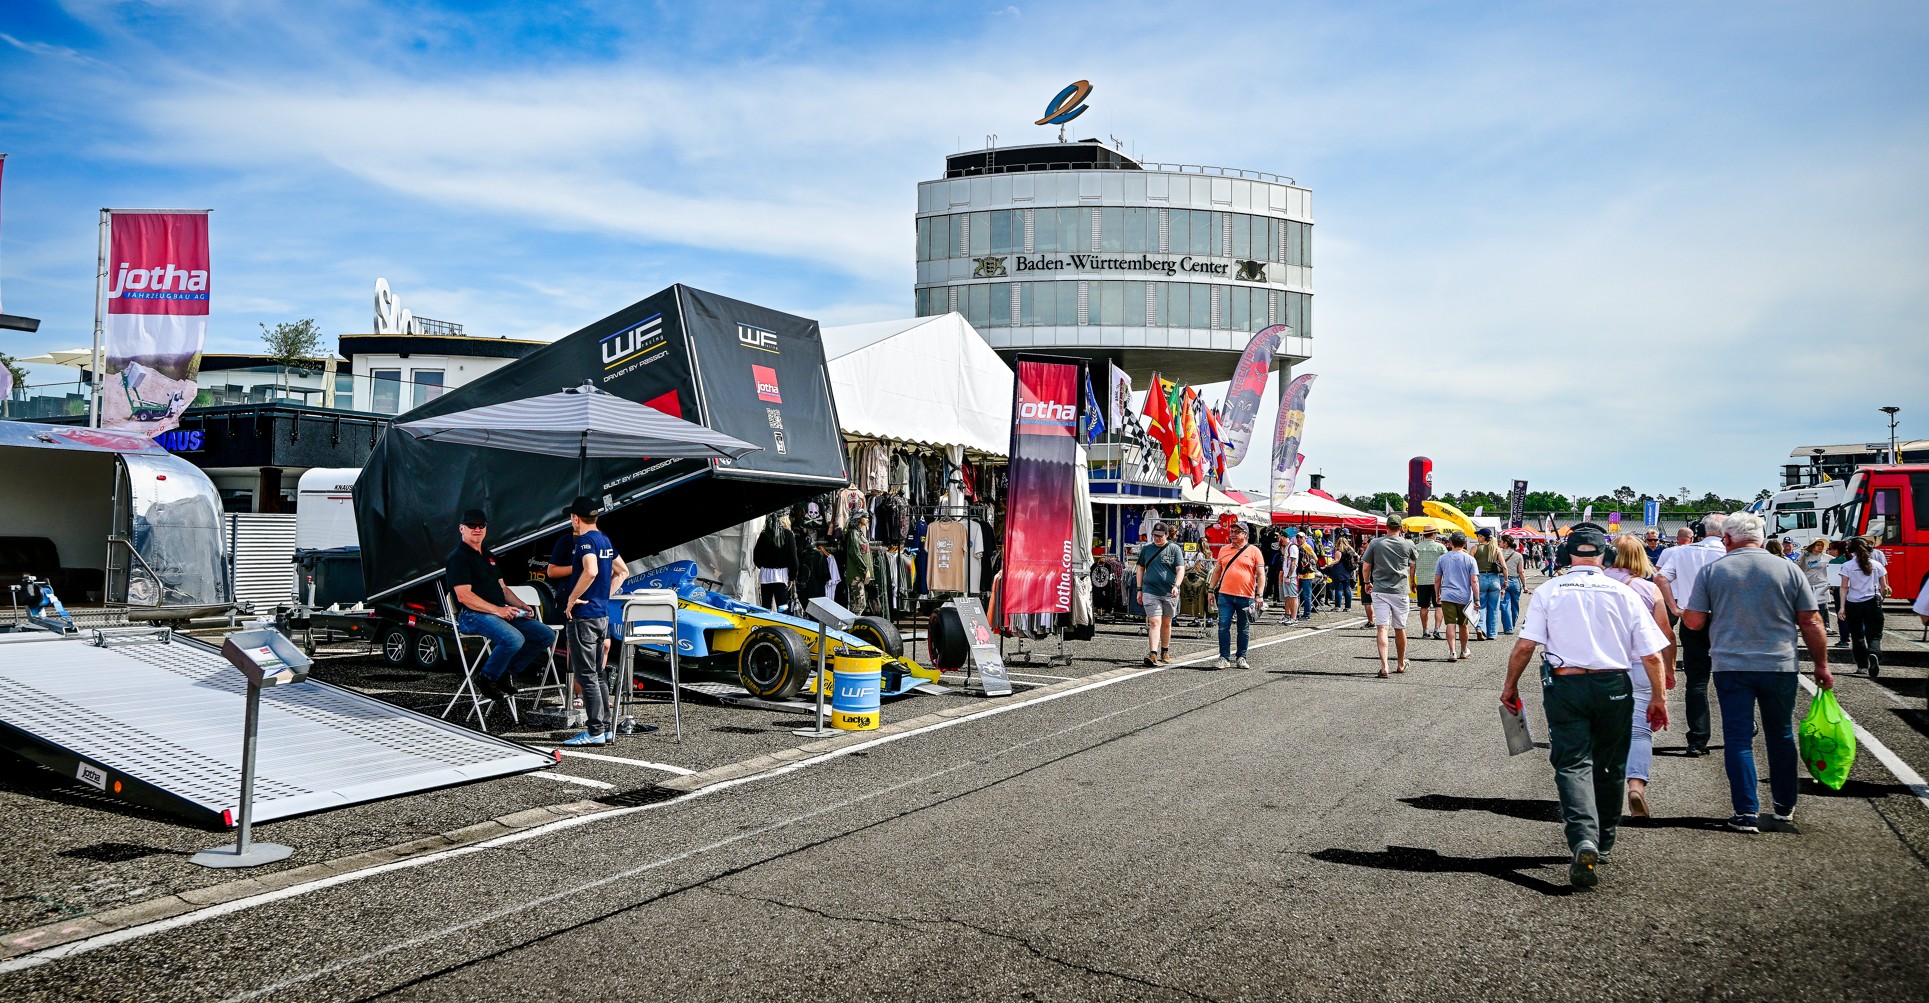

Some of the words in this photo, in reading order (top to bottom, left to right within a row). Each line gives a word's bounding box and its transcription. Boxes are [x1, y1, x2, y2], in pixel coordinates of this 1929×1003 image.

[1016, 254, 1177, 276] Baden-Württemberg
[1180, 256, 1229, 274] Center
[108, 262, 208, 299] jotha
[127, 292, 190, 300] FAHRZEUGBAU
[602, 317, 662, 364] WF
[738, 325, 778, 347] WF
[757, 380, 779, 394] jotha
[160, 431, 201, 452] AUS
[841, 687, 875, 698] WF
[81, 766, 101, 782] jotha
